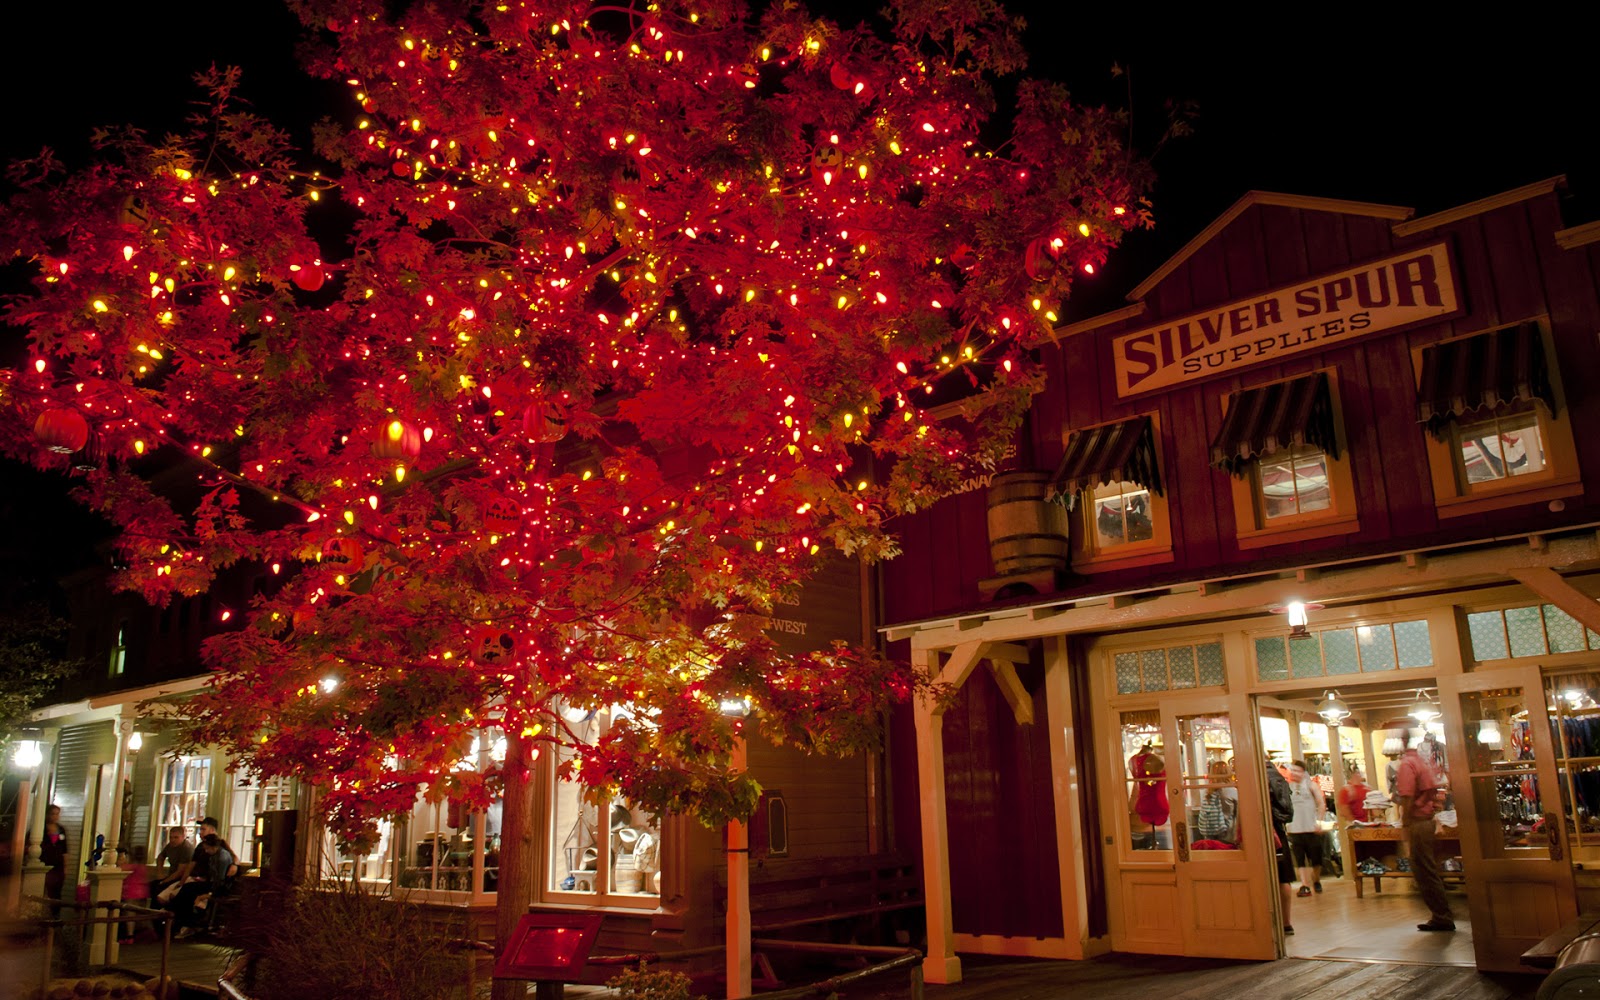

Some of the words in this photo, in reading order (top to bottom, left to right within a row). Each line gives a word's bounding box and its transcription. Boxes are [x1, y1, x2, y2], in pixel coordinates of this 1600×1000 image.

[1123, 297, 1283, 390] SILVER
[1294, 253, 1445, 317] SPUR
[1183, 311, 1372, 376] SUPPLIES
[771, 618, 807, 635] WEST
